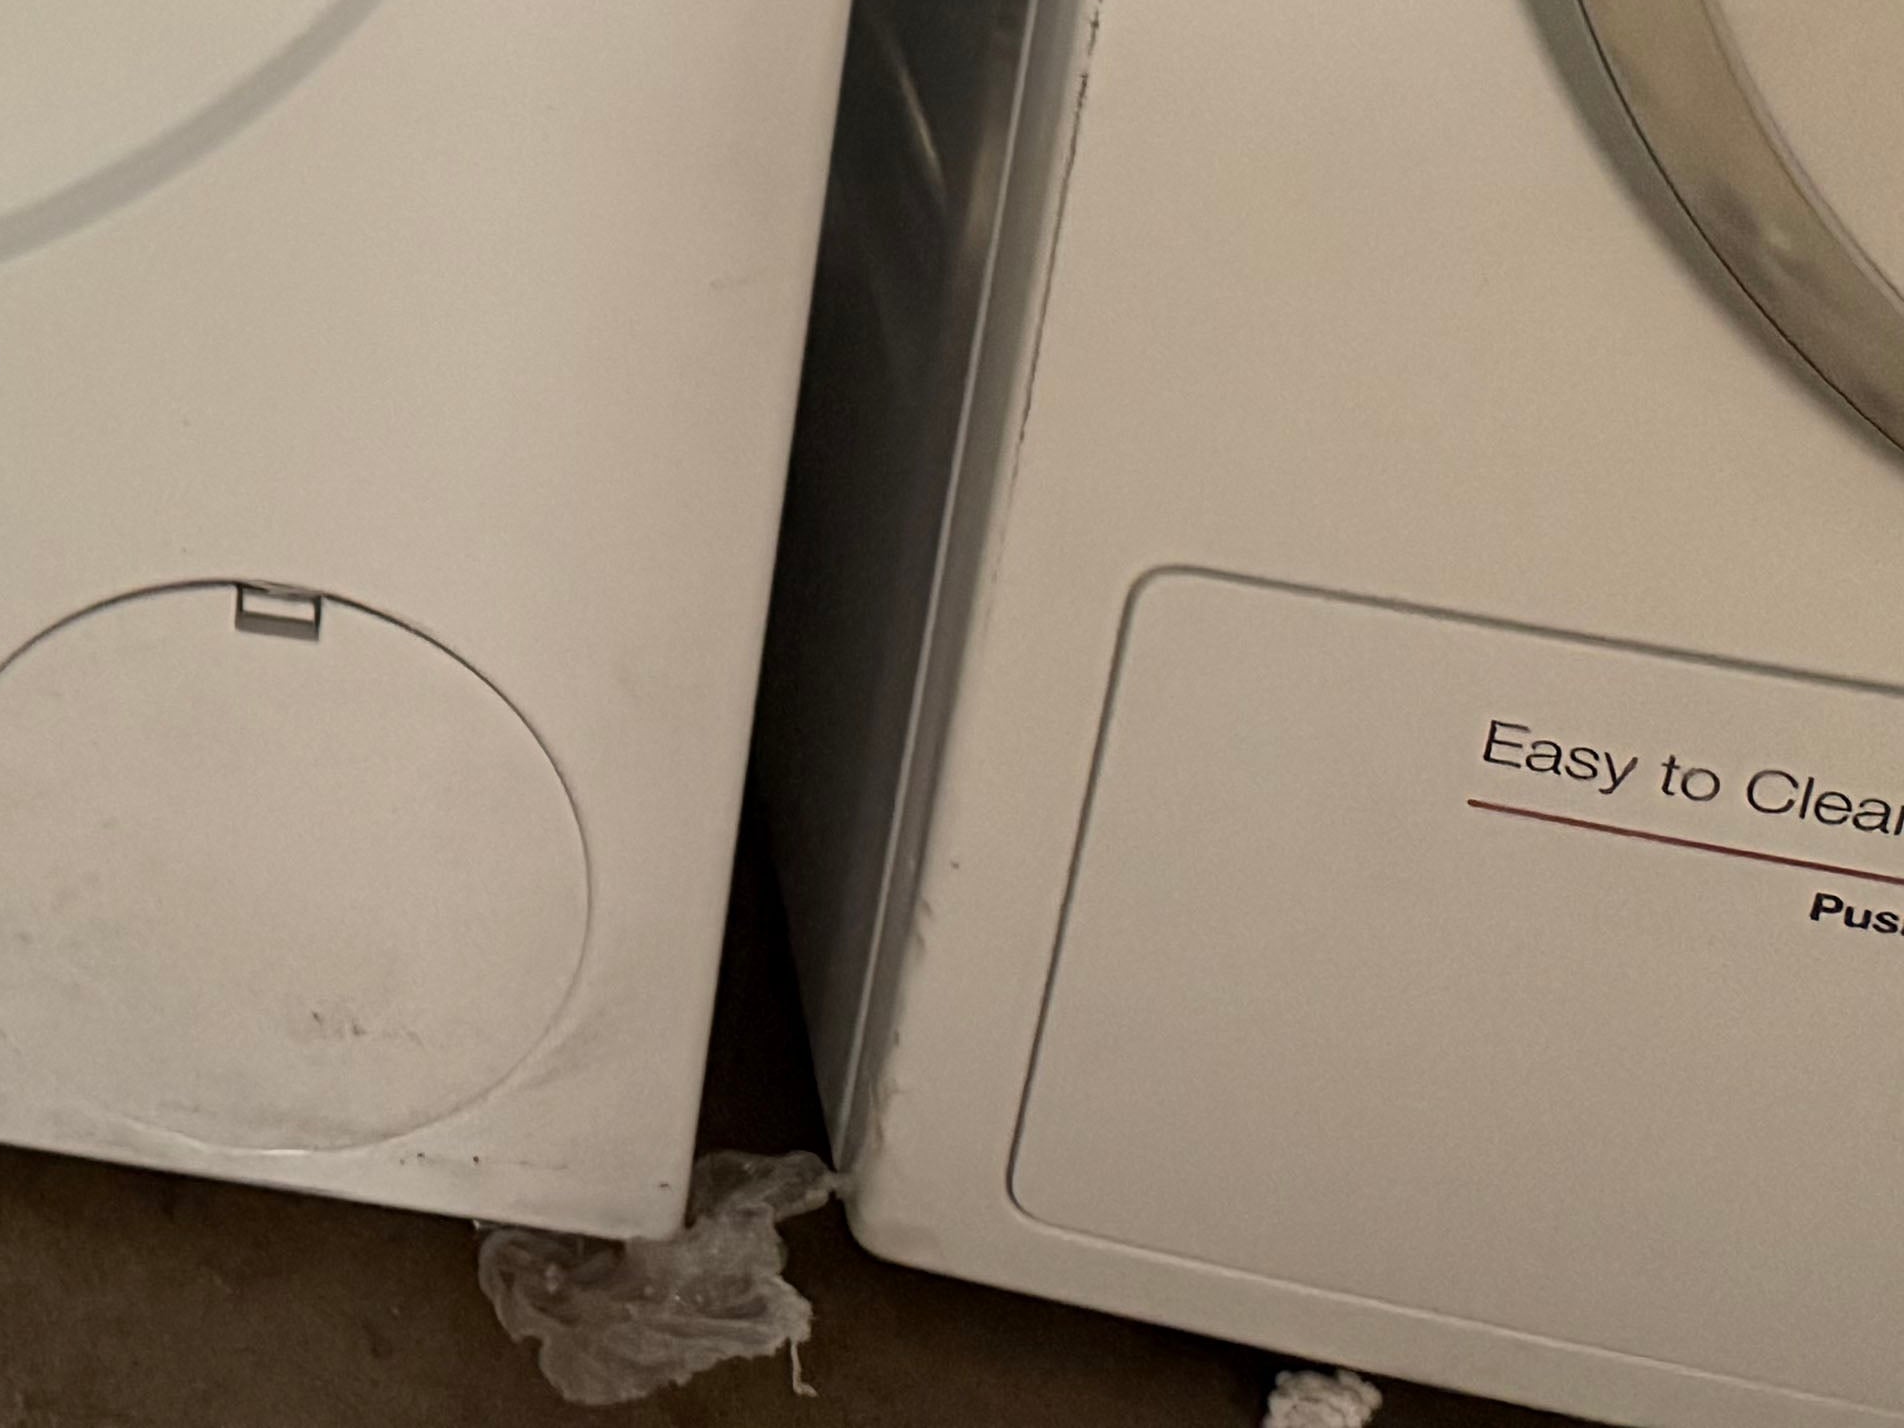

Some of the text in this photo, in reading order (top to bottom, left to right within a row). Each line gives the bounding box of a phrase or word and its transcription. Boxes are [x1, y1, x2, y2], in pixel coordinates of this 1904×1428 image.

[1483, 720, 1638, 795] Easy
[1661, 754, 1720, 801] to
[1809, 892, 1904, 937] Pus
